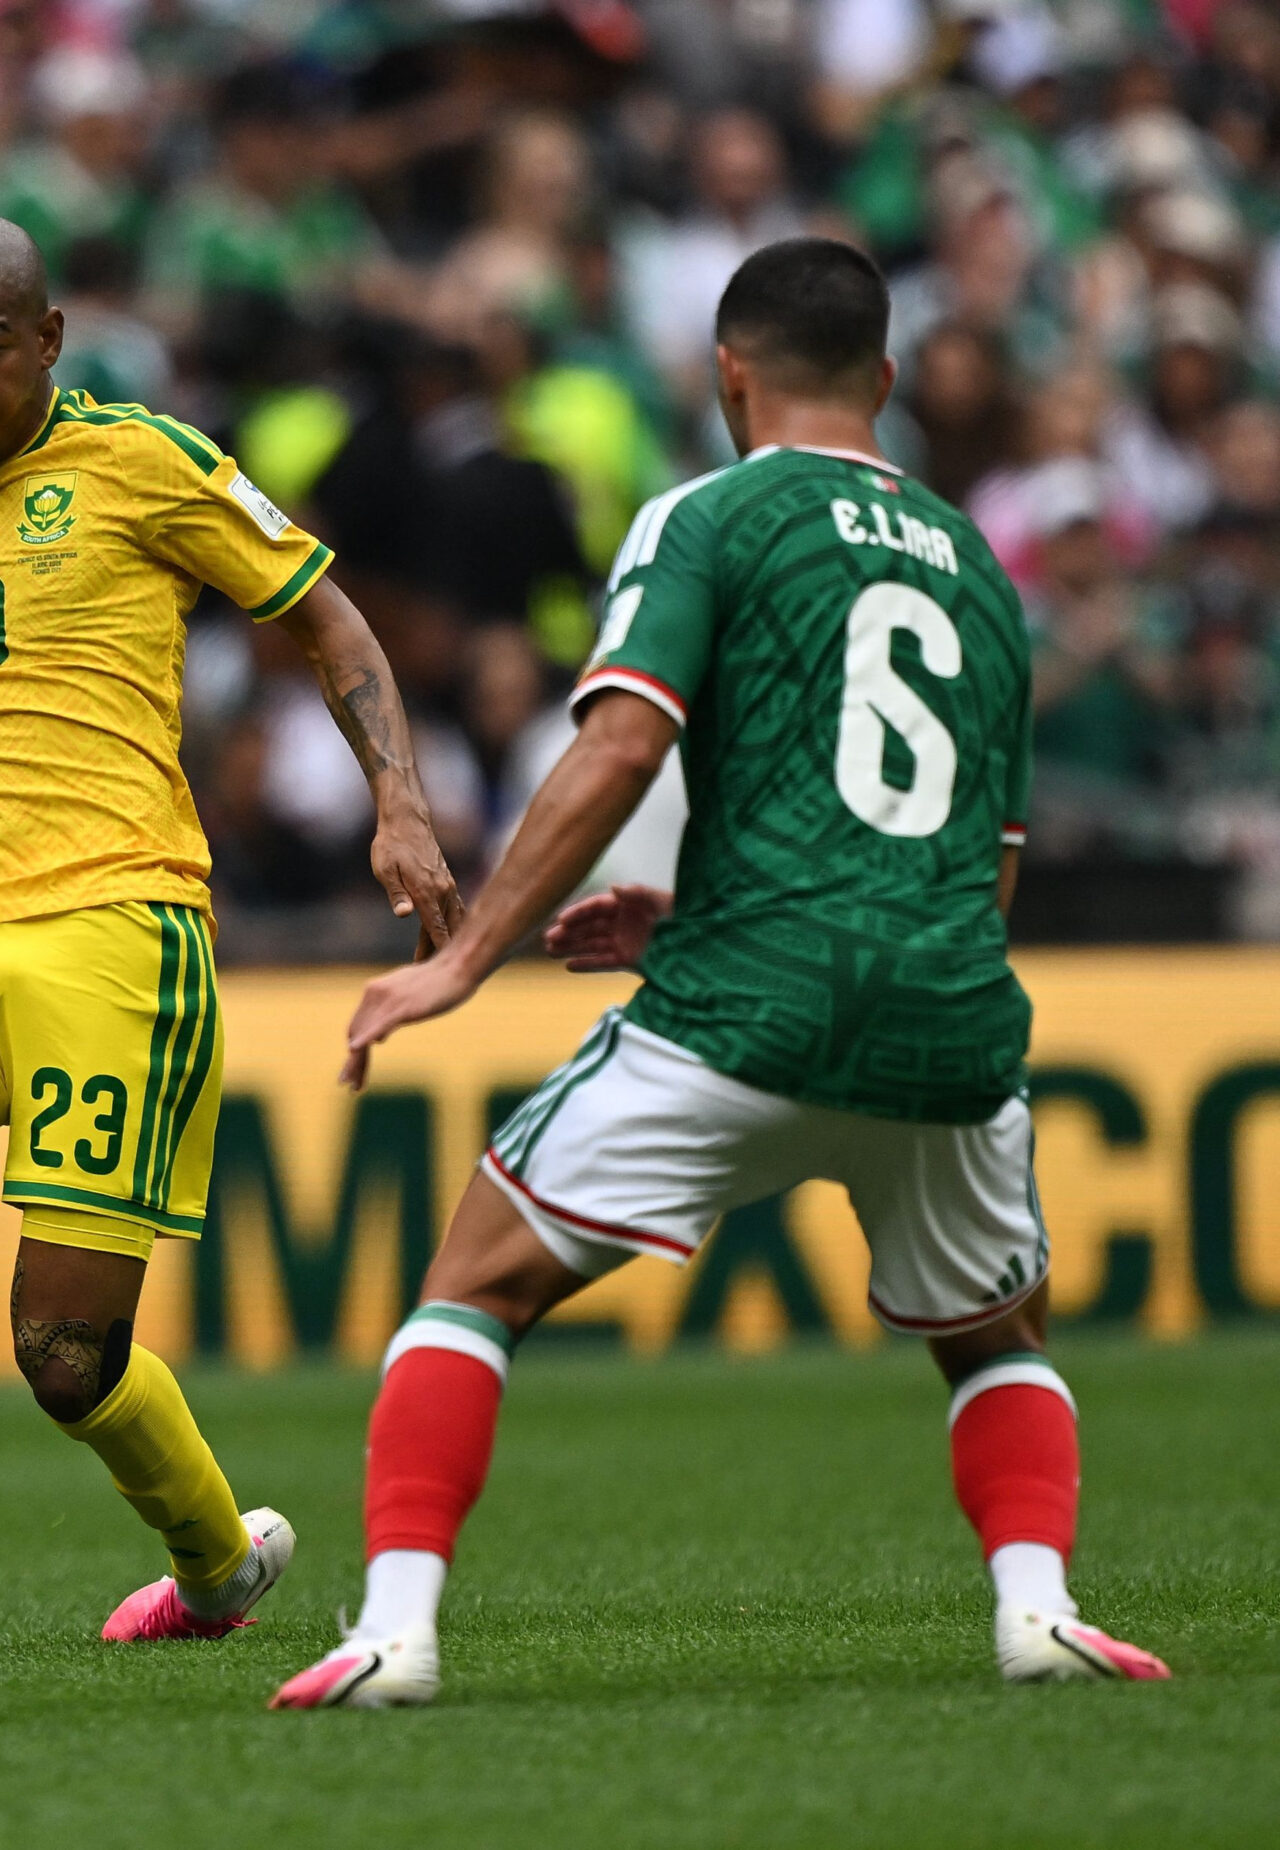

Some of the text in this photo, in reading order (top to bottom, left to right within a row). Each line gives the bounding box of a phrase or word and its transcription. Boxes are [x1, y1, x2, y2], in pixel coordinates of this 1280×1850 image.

[23, 530, 65, 543] SOUTH AFRICA
[830, 498, 959, 576] E.LIRA
[835, 581, 962, 837] 6
[30, 1066, 128, 1175] 23
[197, 1064, 1280, 1348] MXC
